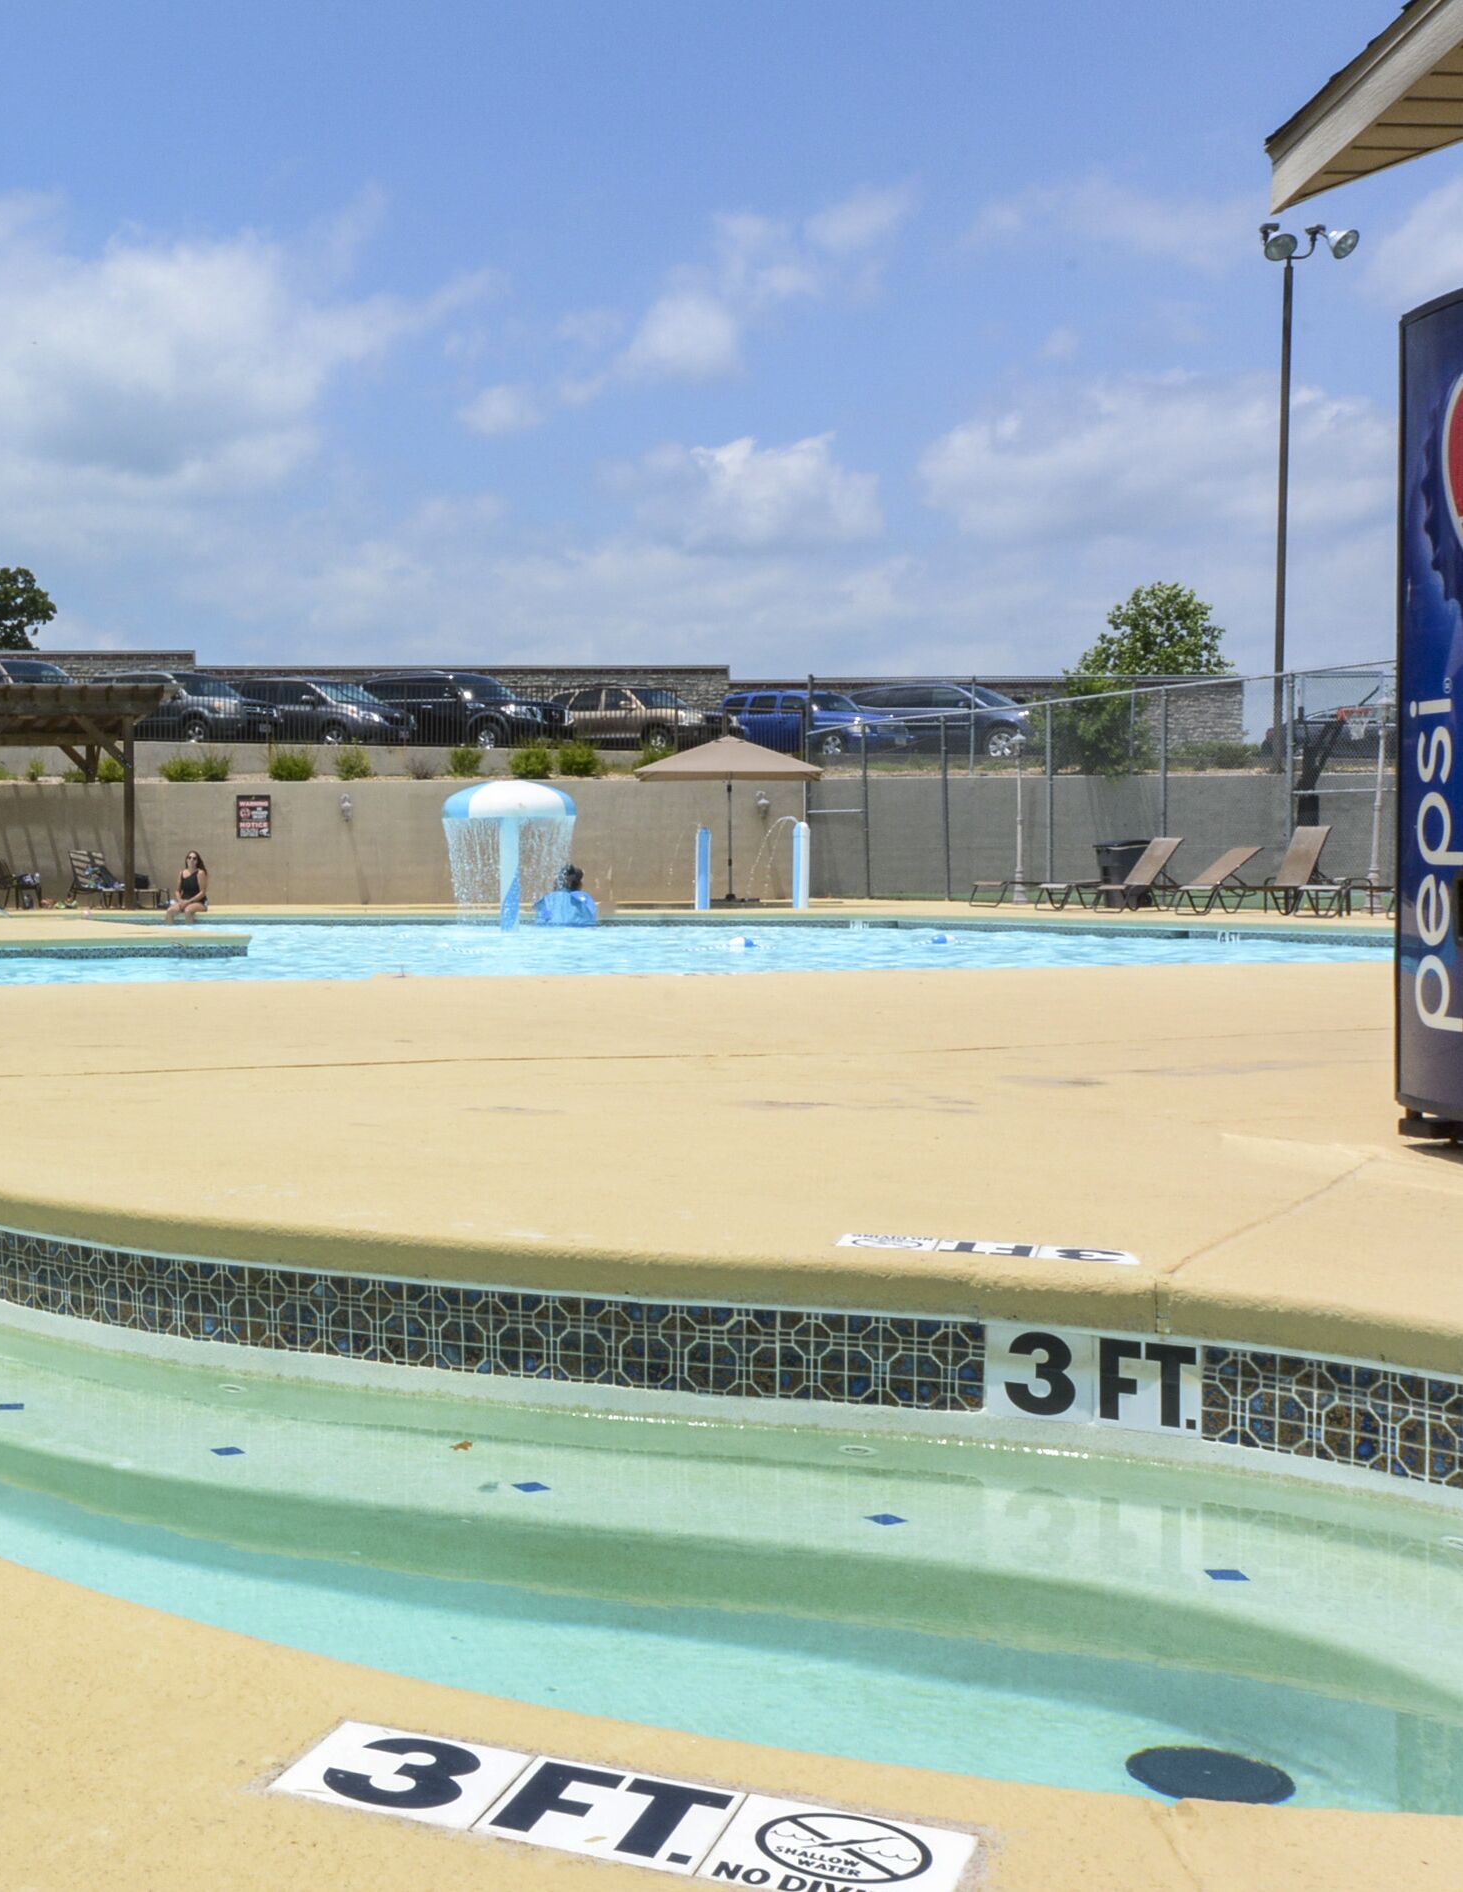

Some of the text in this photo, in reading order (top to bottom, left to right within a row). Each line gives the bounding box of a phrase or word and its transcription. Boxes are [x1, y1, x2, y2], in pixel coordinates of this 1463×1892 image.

[1410, 698, 1463, 1032] pepsi
[1004, 1331, 1197, 1431] 3 FT.
[323, 1737, 735, 1865] 3 FT.
[711, 1861, 771, 1885] NO
[774, 1845, 861, 1868] SHALLOW
[797, 1858, 862, 1877] WATER
